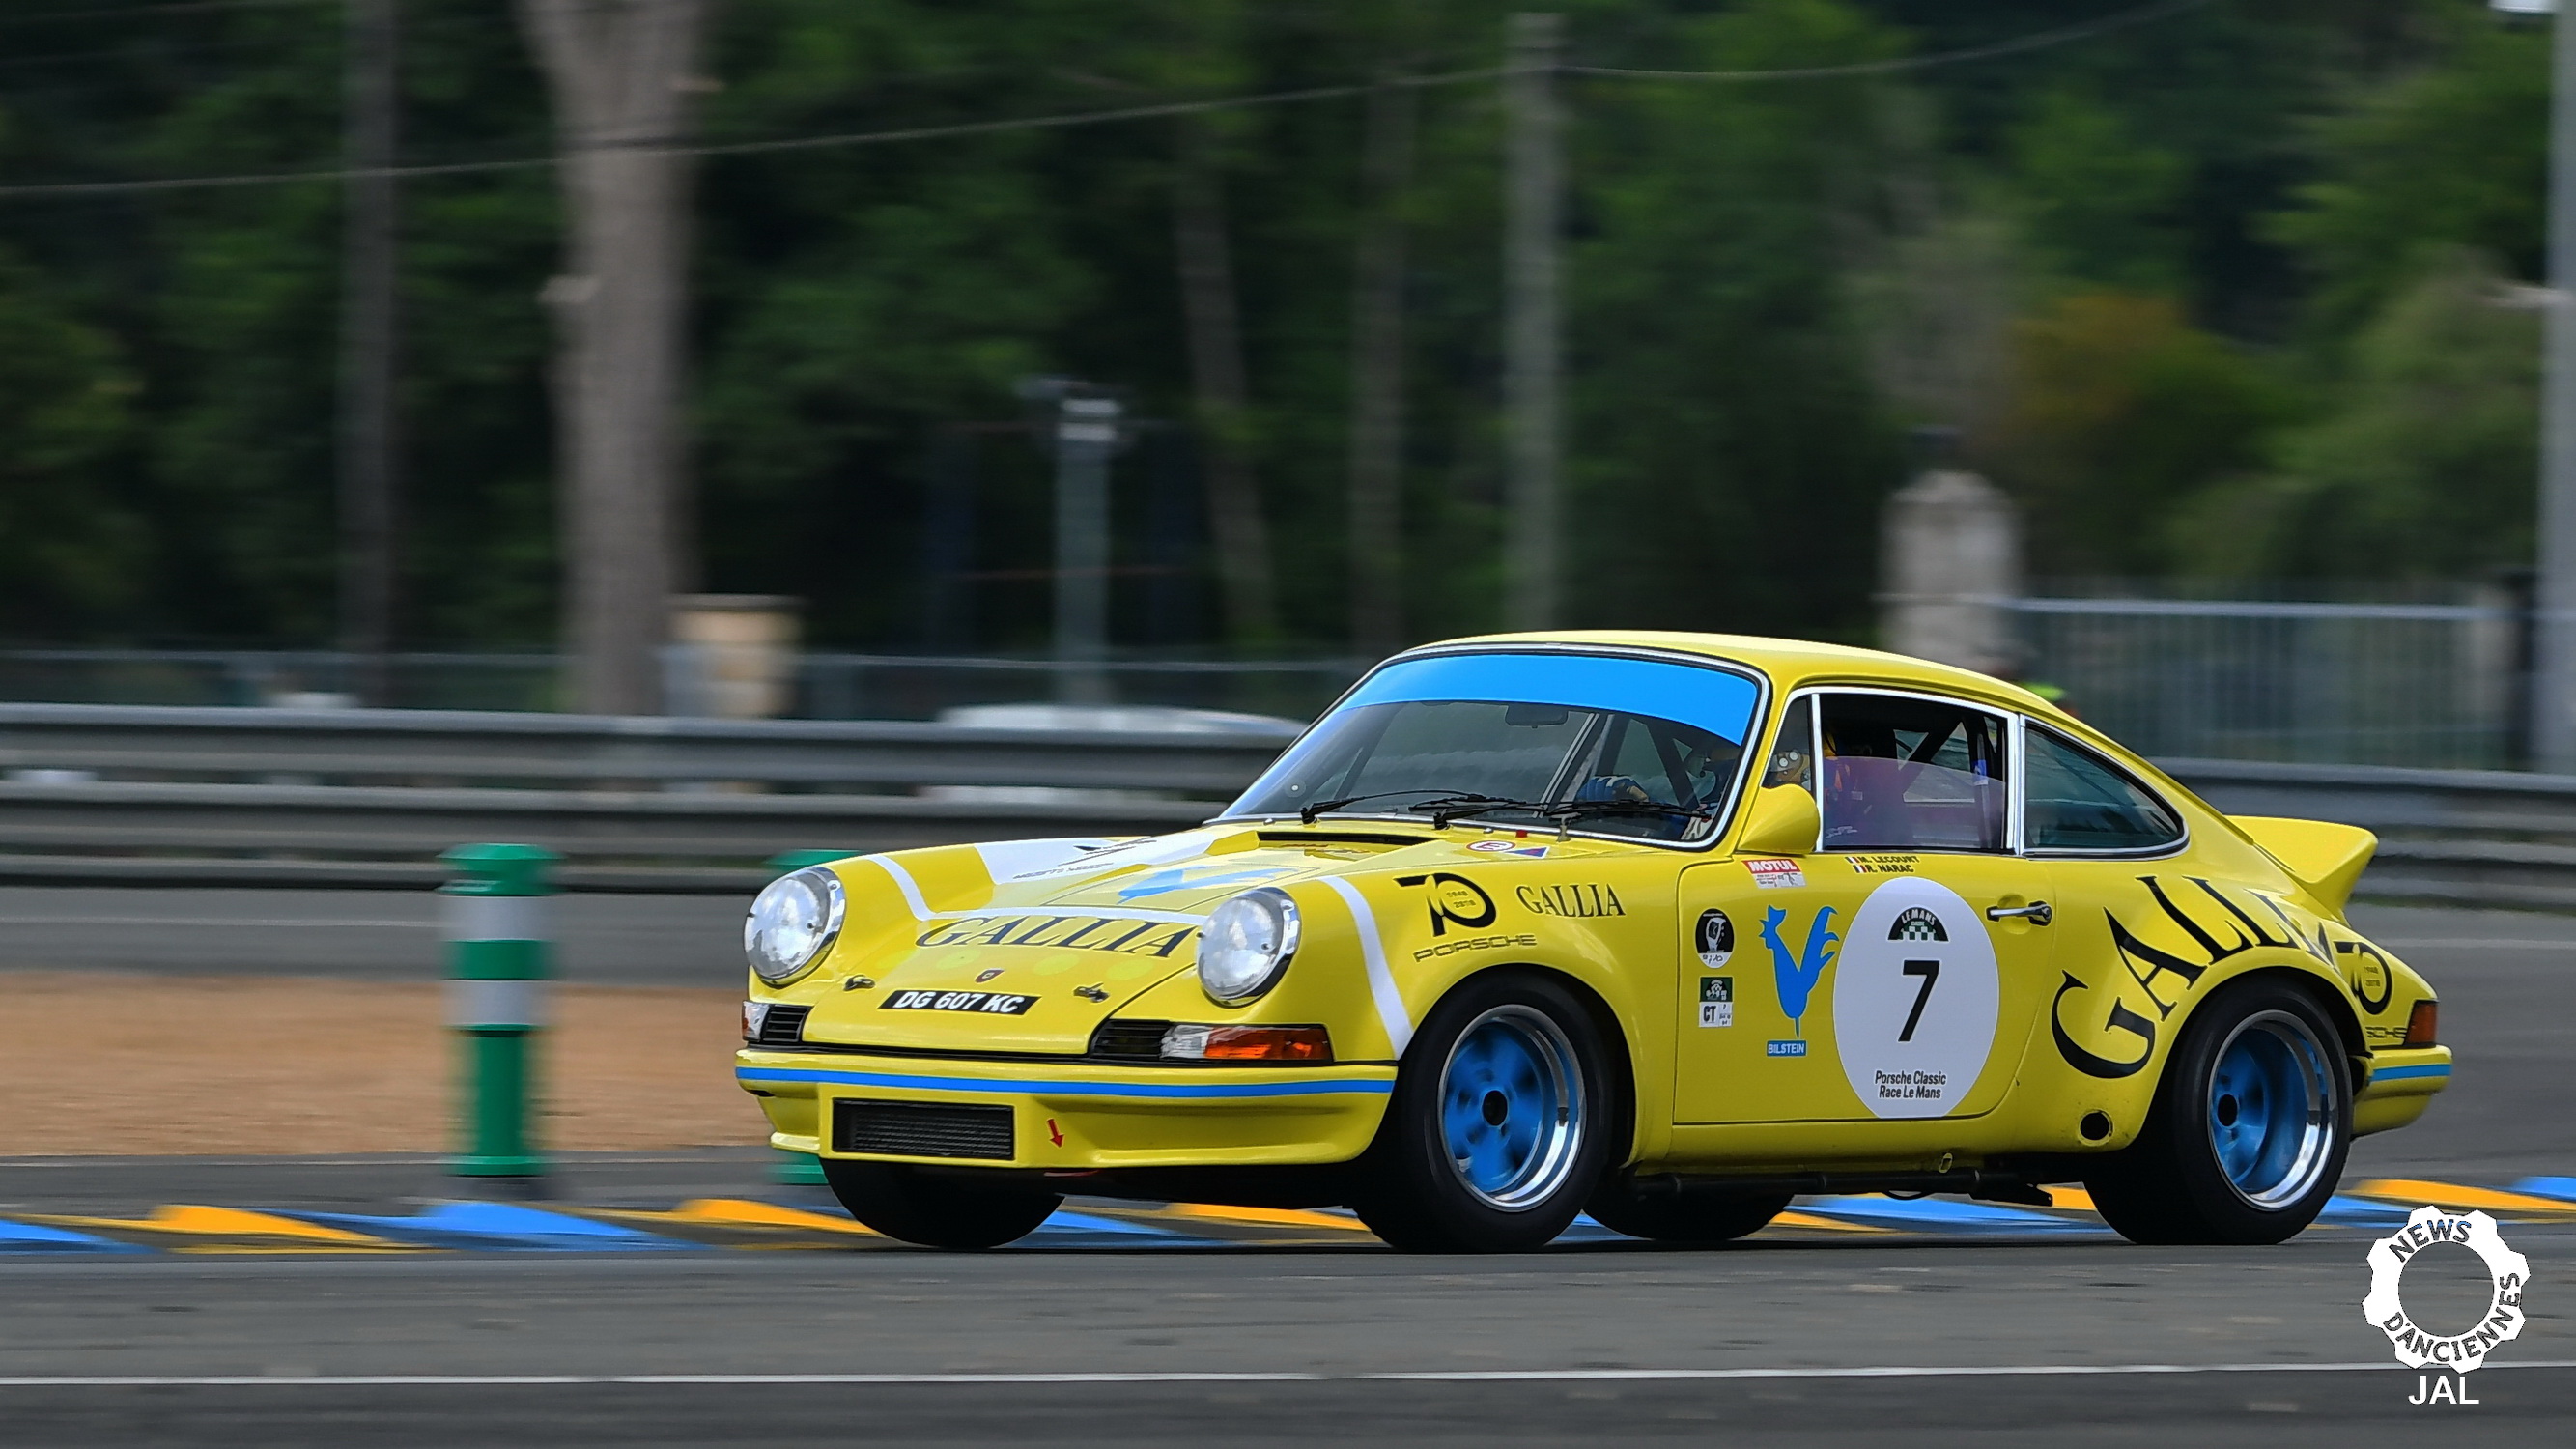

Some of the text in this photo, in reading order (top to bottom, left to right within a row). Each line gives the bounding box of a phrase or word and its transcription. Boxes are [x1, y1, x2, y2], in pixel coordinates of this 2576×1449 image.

[1747, 859, 1798, 872] MOTUL
[1877, 865, 1914, 873] NARAC
[1515, 883, 1626, 918] GALLIA
[1901, 908, 1937, 925] LE MANS
[915, 915, 1198, 958] GALLIA
[1412, 933, 1538, 963] PORSCHE
[892, 991, 1025, 1013] DG 607 KC
[1897, 959, 1940, 1043] 7
[1703, 1005, 1717, 1022] CT
[1768, 1043, 1805, 1054] BILSTEIN
[1875, 1069, 1947, 1085] Porsche Classic
[1879, 1084, 1941, 1099] Race Le Mans
